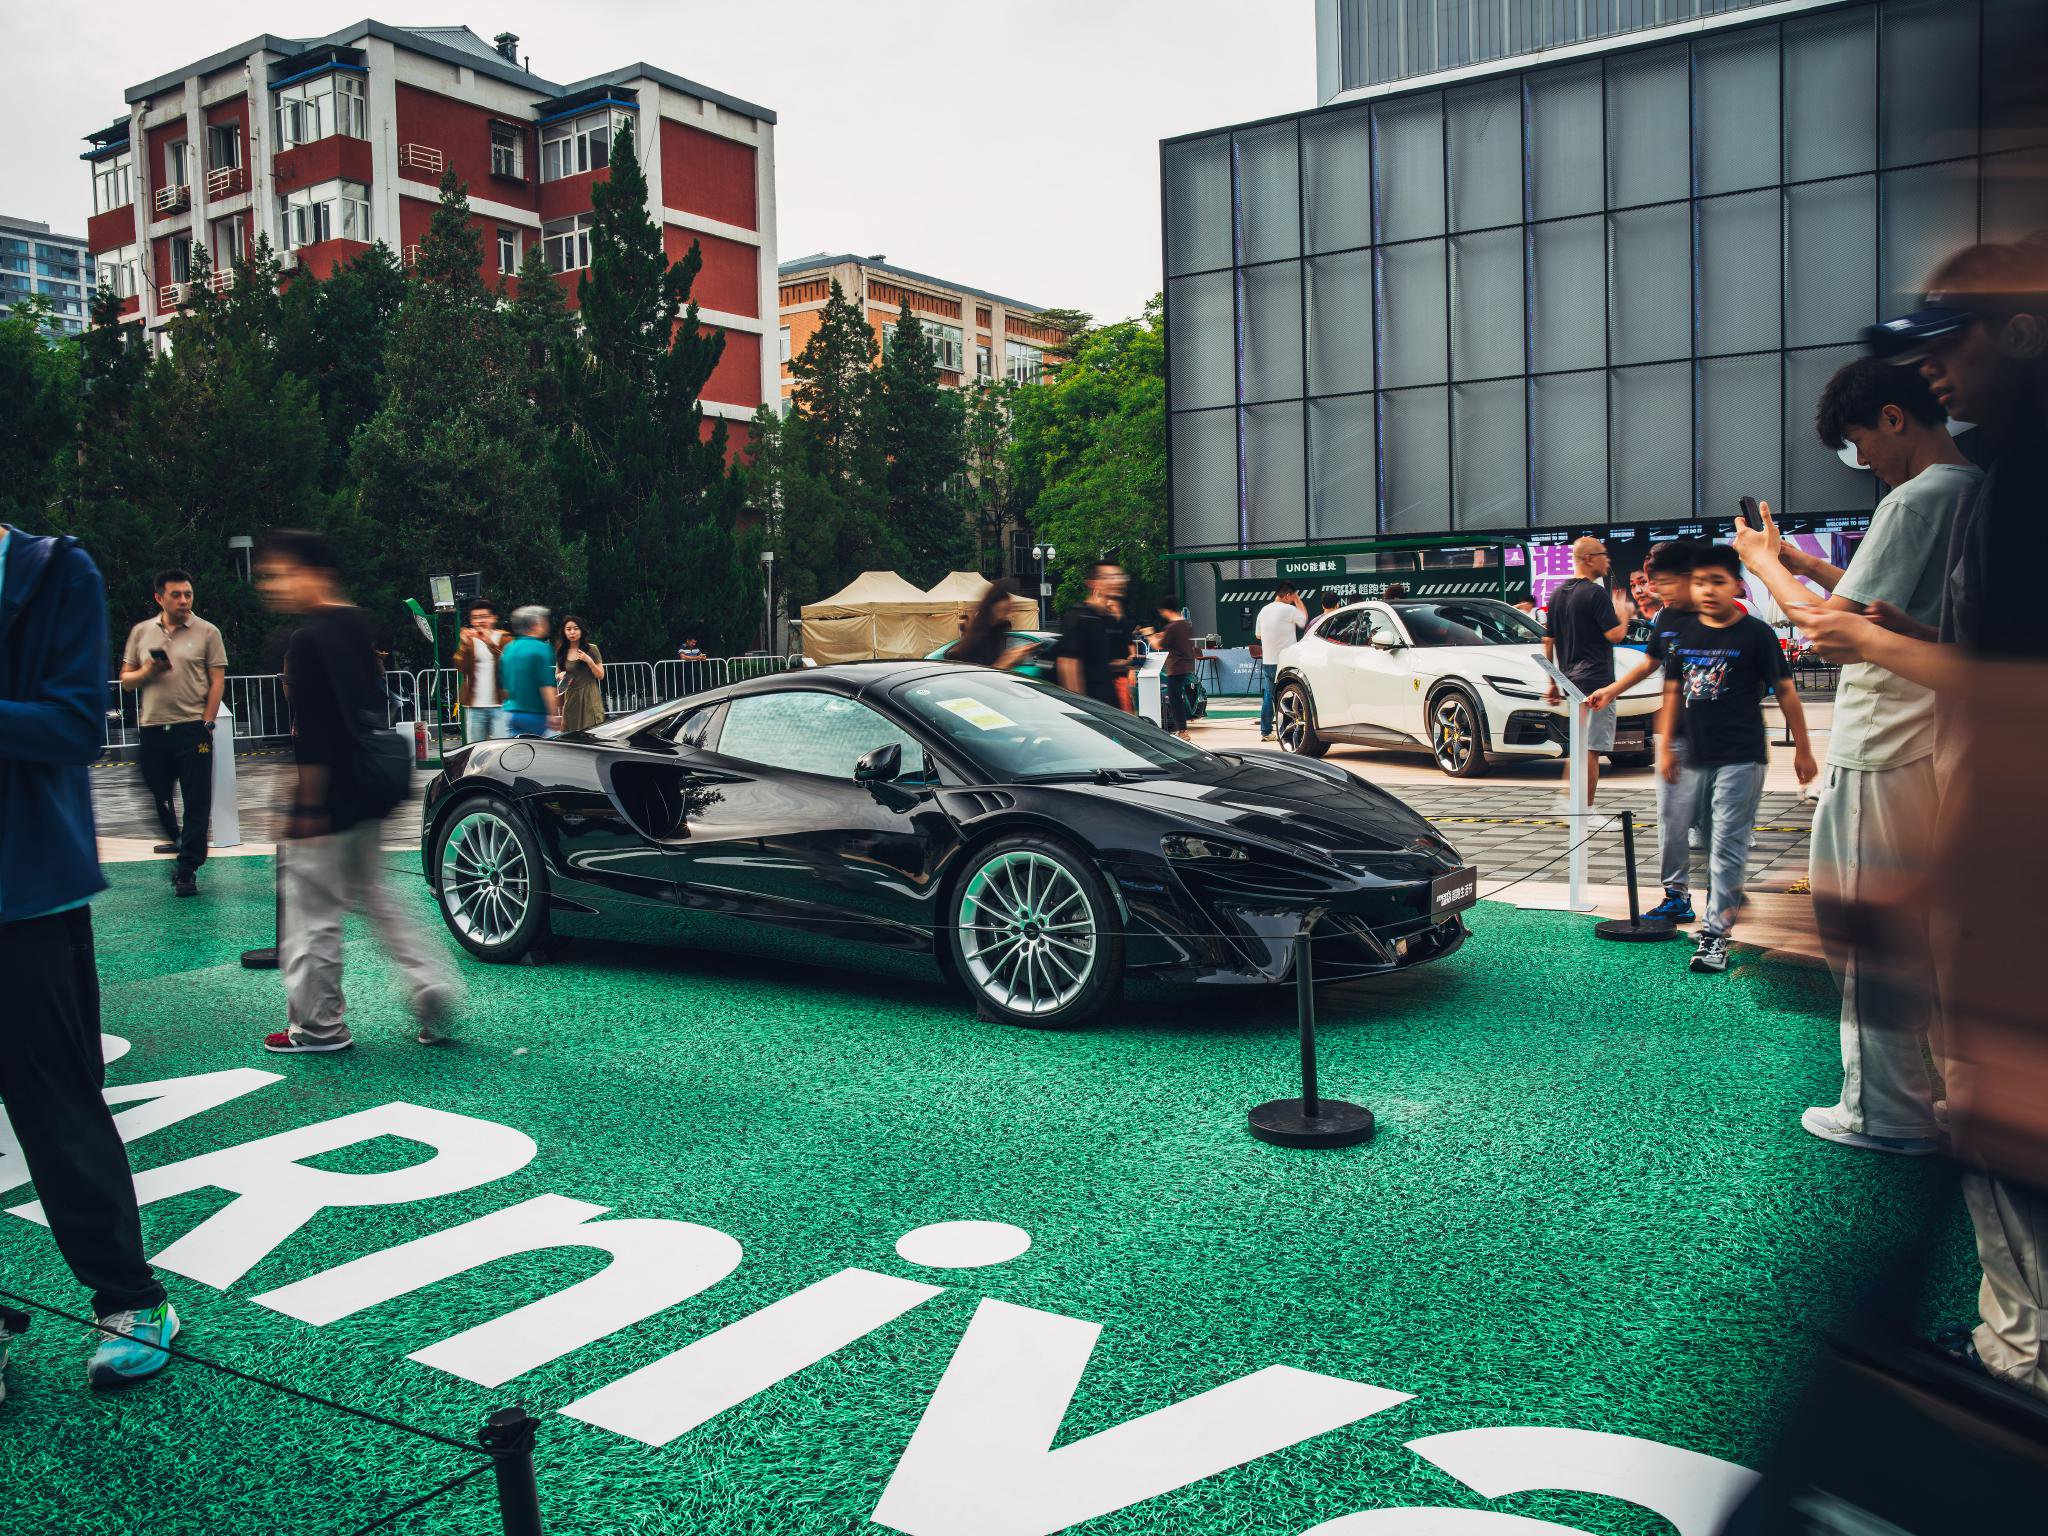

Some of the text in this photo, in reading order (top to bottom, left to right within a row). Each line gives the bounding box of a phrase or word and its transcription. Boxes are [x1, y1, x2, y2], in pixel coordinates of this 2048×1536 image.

[1286, 561, 1337, 573] UNO能量处
[1358, 582, 1411, 596] 超跑生节
